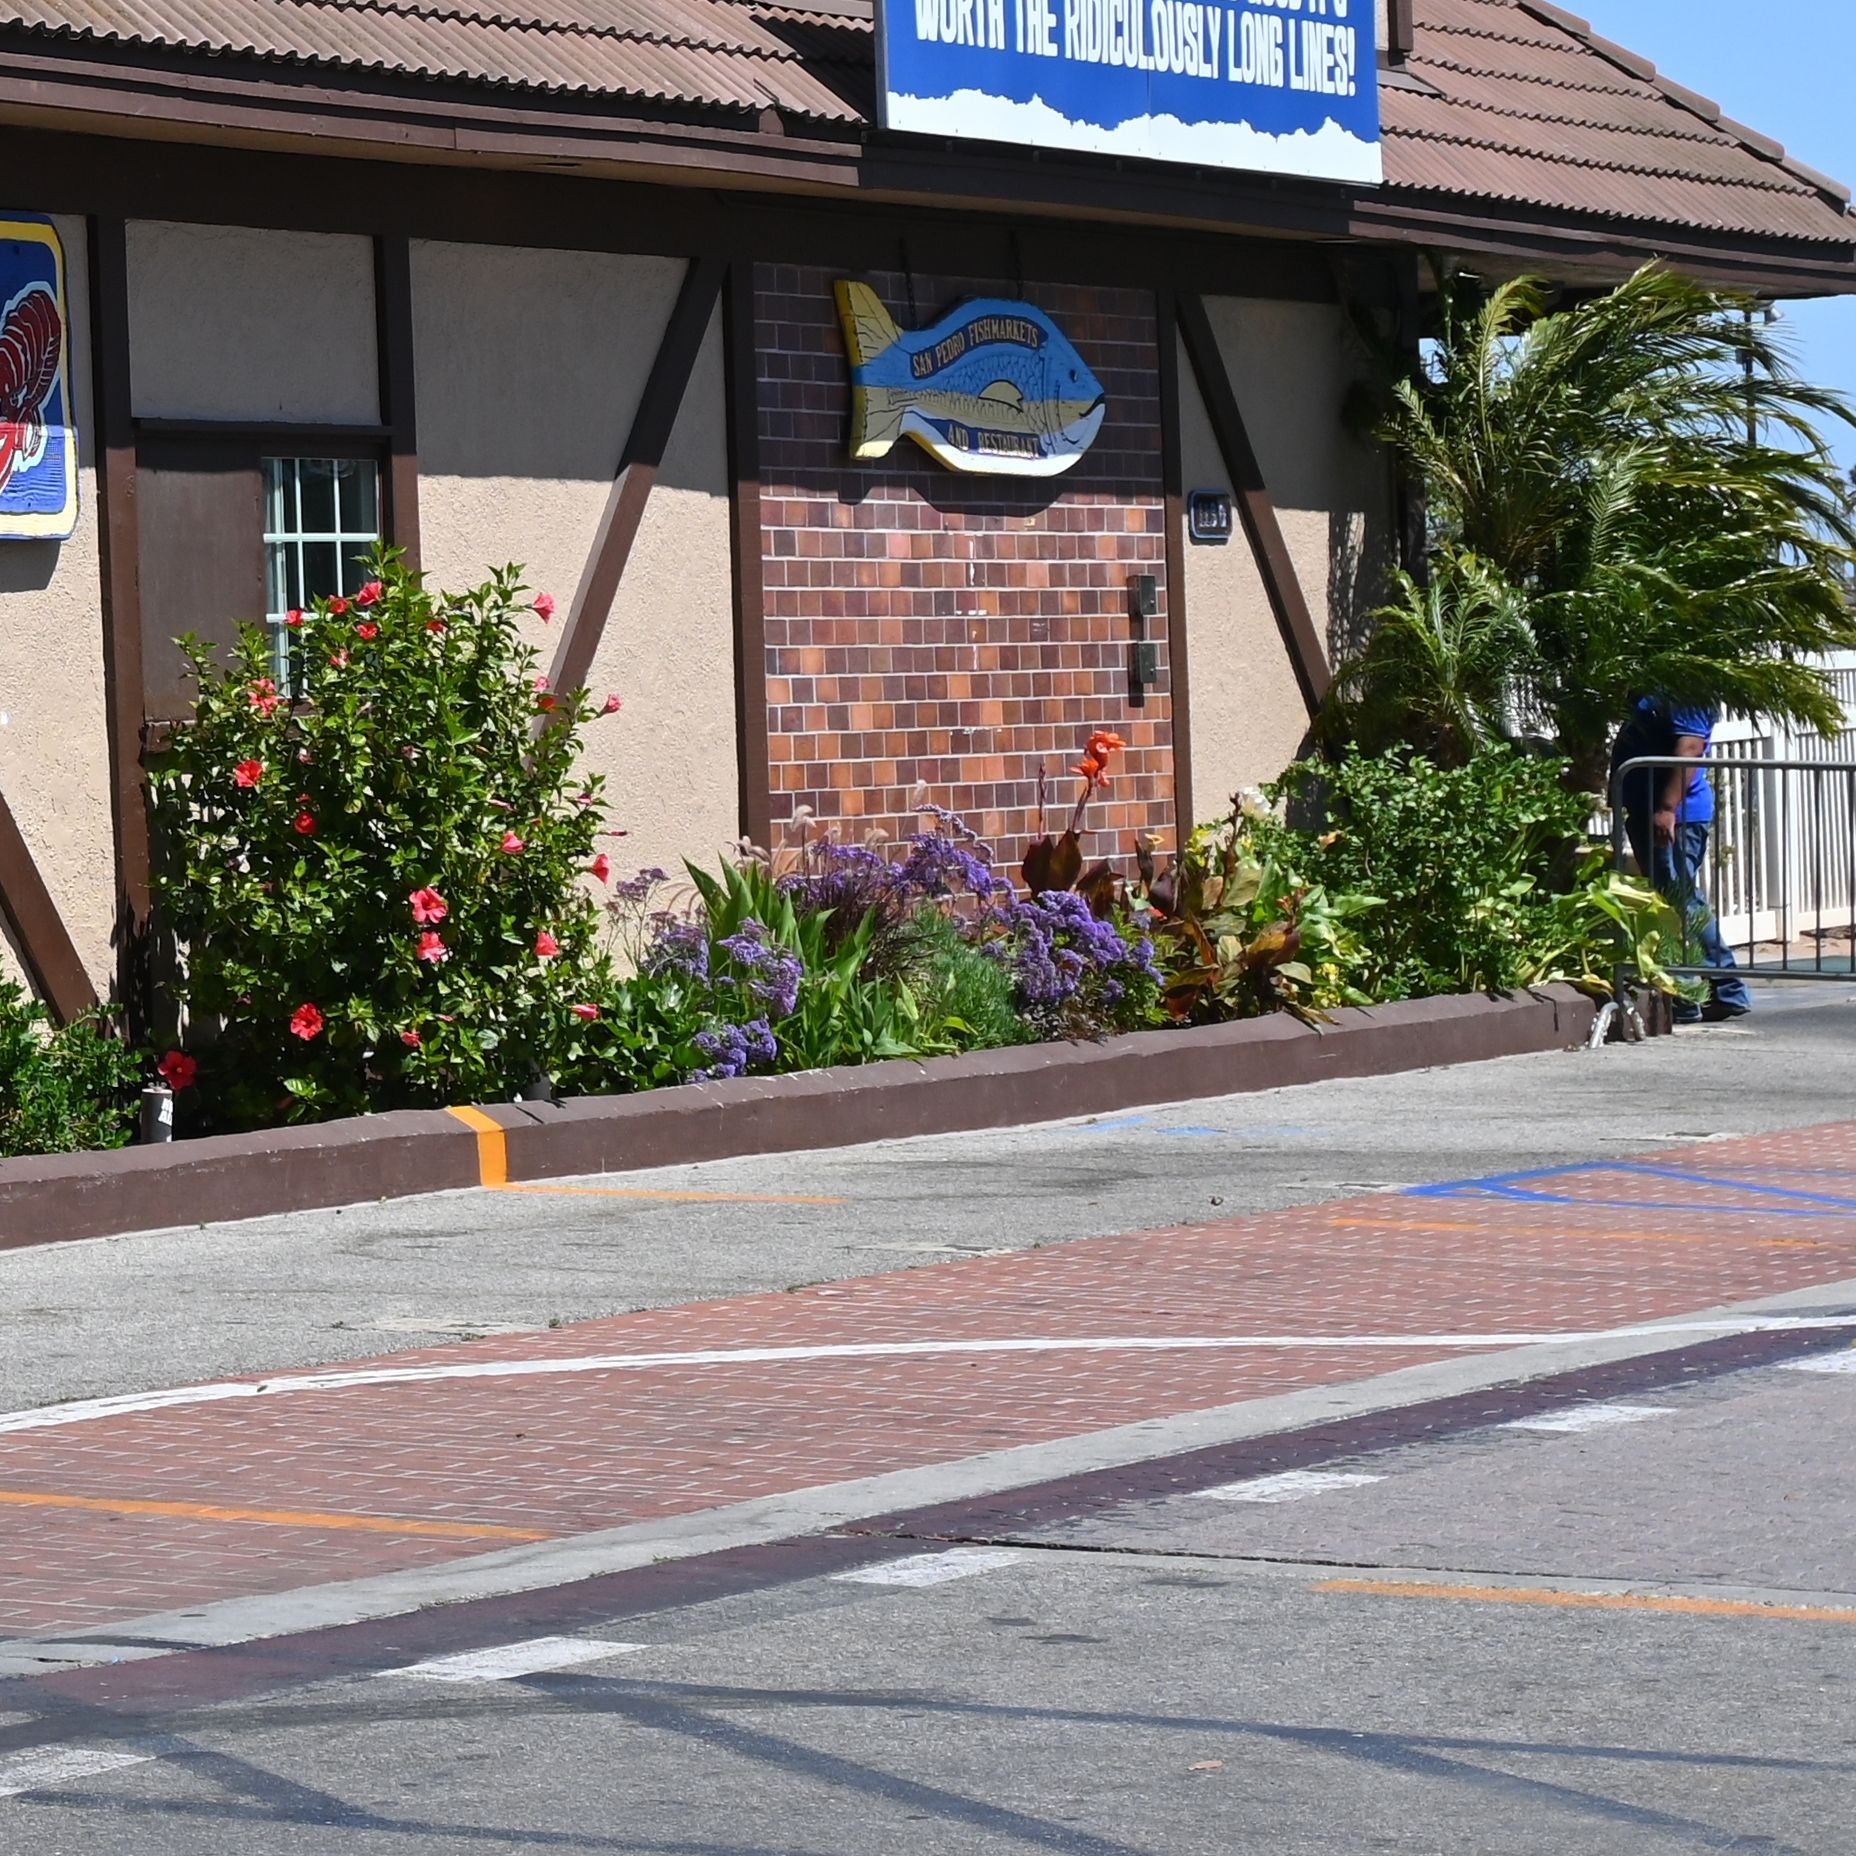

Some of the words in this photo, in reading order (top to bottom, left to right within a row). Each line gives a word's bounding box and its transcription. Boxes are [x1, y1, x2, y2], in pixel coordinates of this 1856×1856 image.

[1227, 9, 1284, 88] LONG
[1288, 18, 1357, 97] LINES!
[912, 353, 933, 377] SAN
[935, 331, 966, 367] PEDRO
[968, 318, 1038, 348] FISHMARKETS
[948, 423, 969, 452] AND
[977, 431, 1040, 459] RESTAURANT
